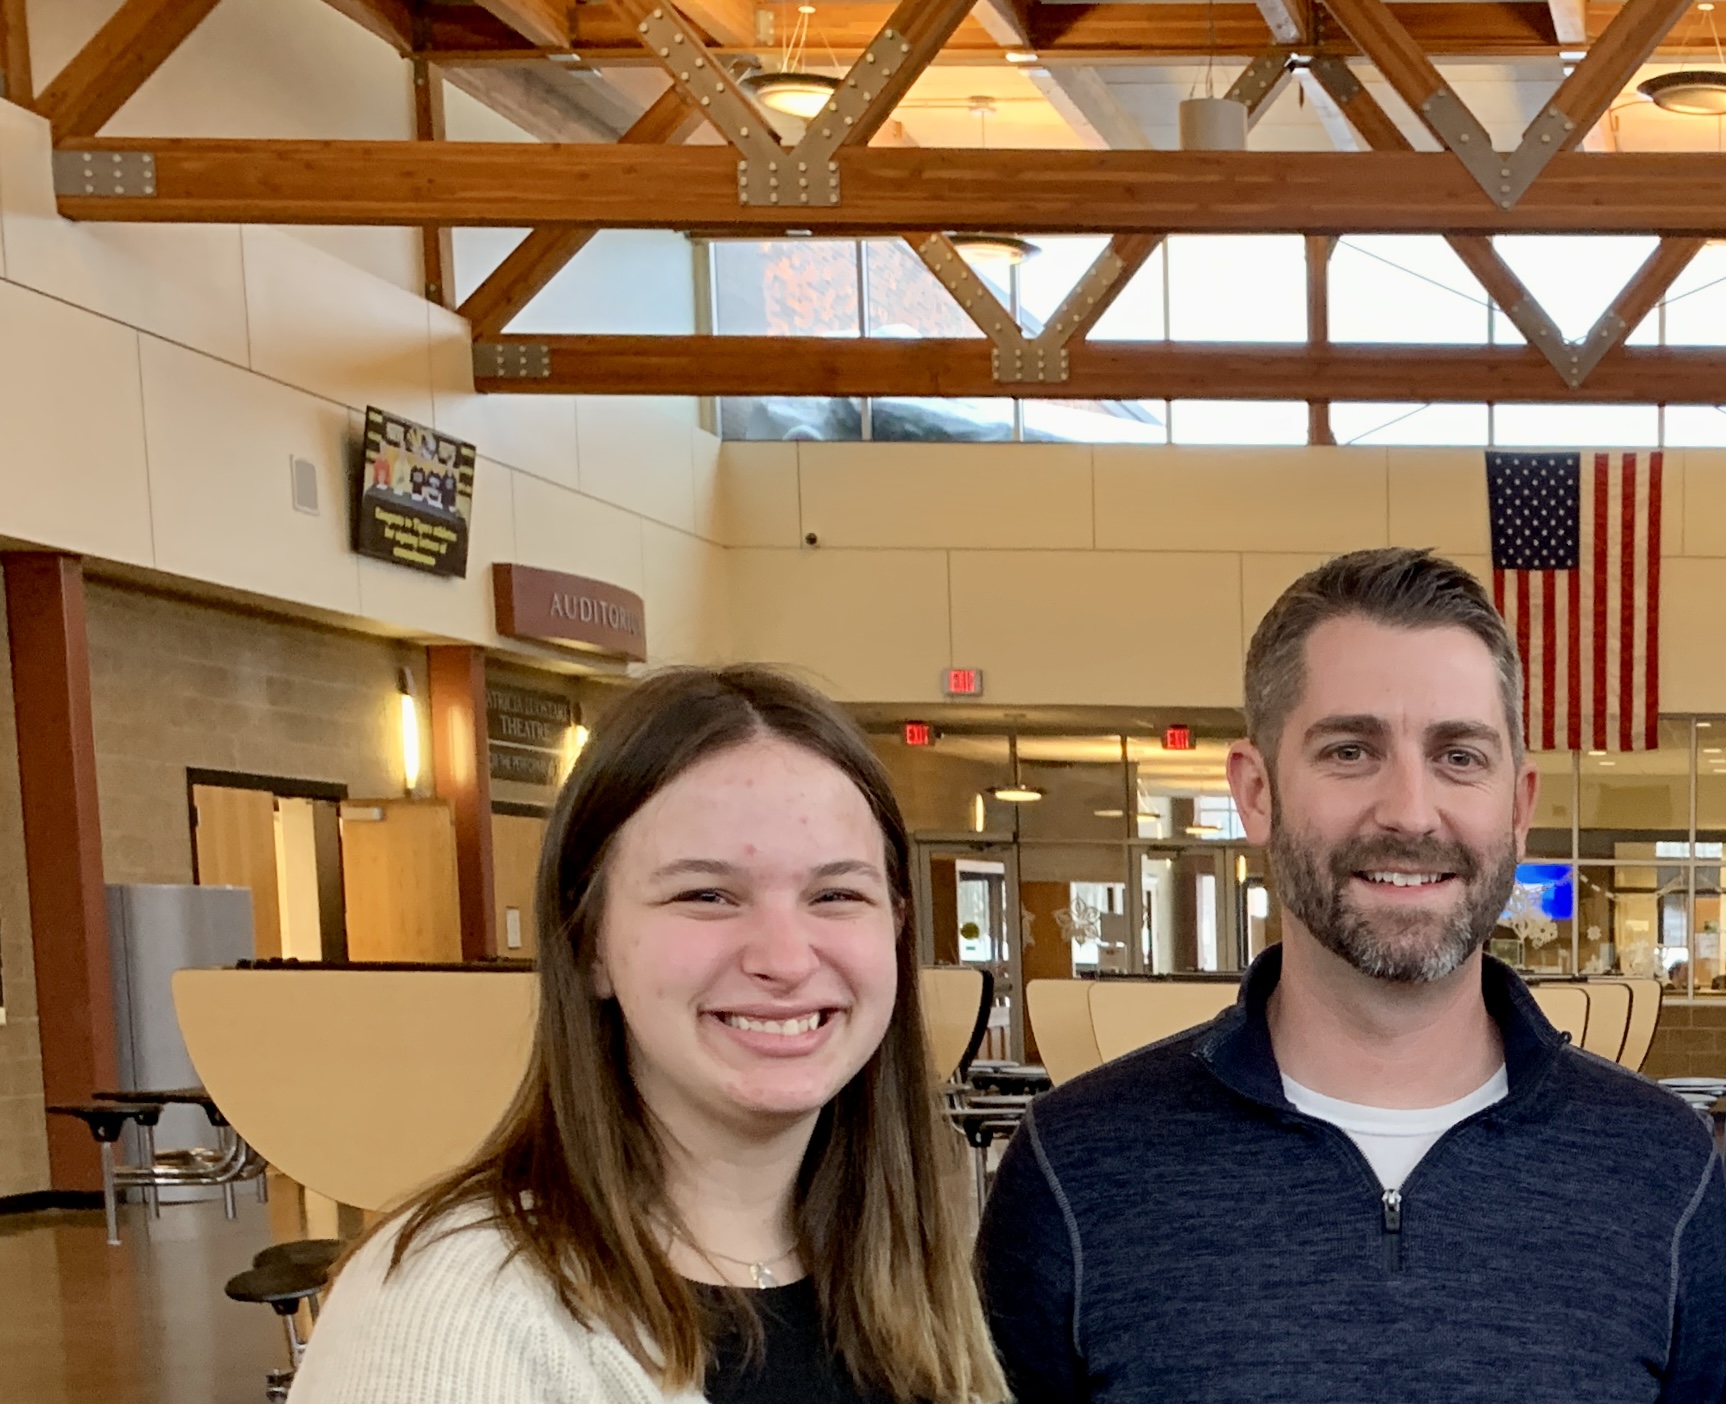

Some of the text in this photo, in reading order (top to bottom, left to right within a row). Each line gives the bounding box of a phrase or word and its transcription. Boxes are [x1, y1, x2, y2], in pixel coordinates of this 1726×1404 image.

[500, 715, 552, 742] THEATRE
[906, 724, 930, 745] EXIT
[1167, 729, 1190, 749] EXIT
